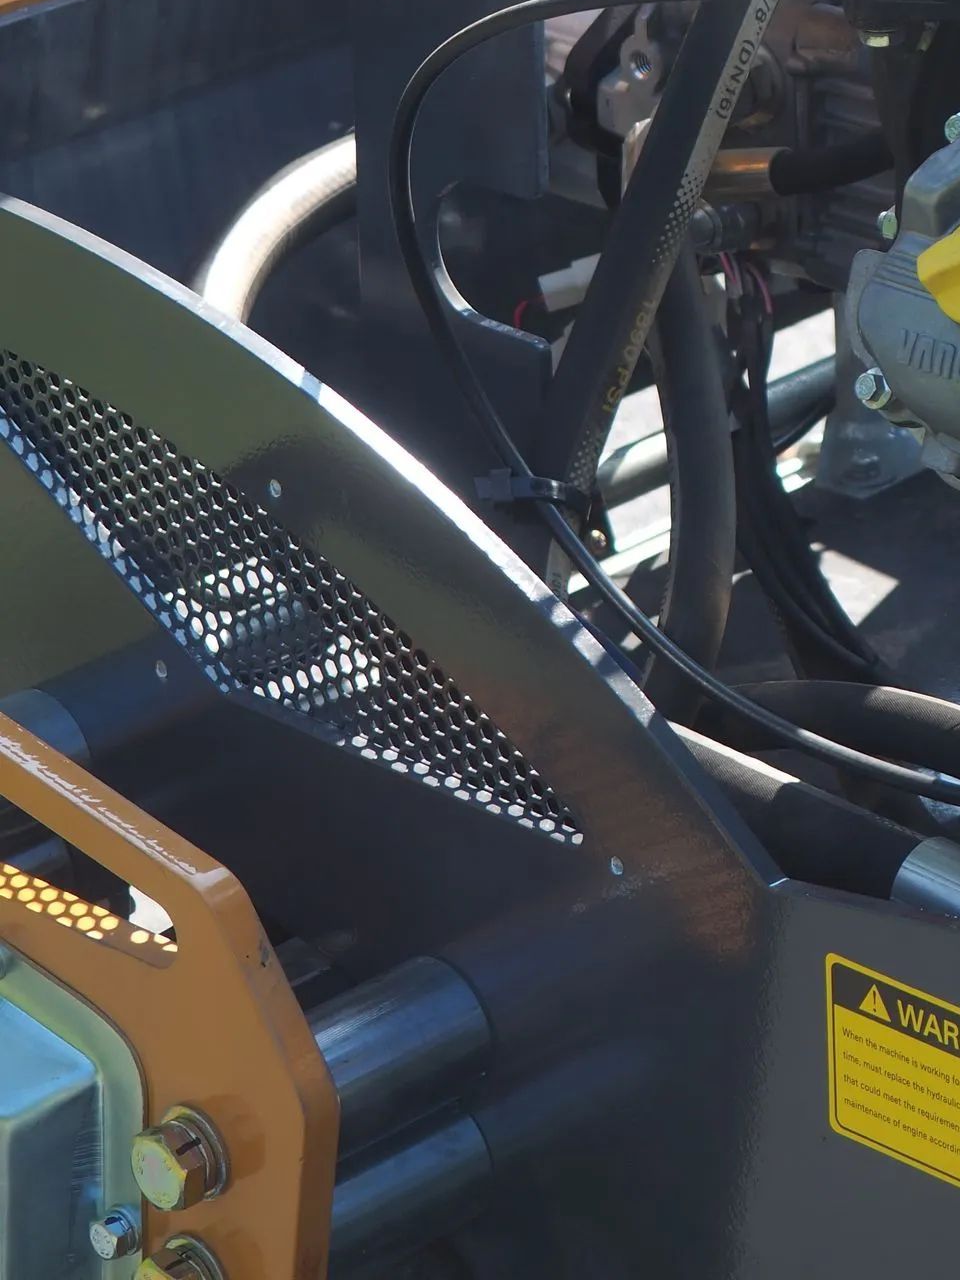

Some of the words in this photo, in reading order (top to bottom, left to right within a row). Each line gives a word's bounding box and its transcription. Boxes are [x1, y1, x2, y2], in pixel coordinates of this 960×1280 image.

[842, 1028, 863, 1043] When
[865, 1038, 877, 1049] the
[879, 1046, 909, 1063] machine
[912, 1058, 917, 1067] is
[920, 1063, 949, 1083] working
[843, 1051, 861, 1067] time,
[863, 1061, 881, 1074] must
[884, 1070, 910, 1087] replace
[912, 1081, 924, 1093] the
[926, 1085, 960, 1109] hydraulic
[843, 1073, 858, 1086] that
[860, 1083, 880, 1096] could
[883, 1092, 901, 1105] meet
[903, 1099, 915, 1111] the
[844, 1098, 891, 1123] maintenance
[893, 1119, 901, 1128] of
[902, 1123, 927, 1139] engine
